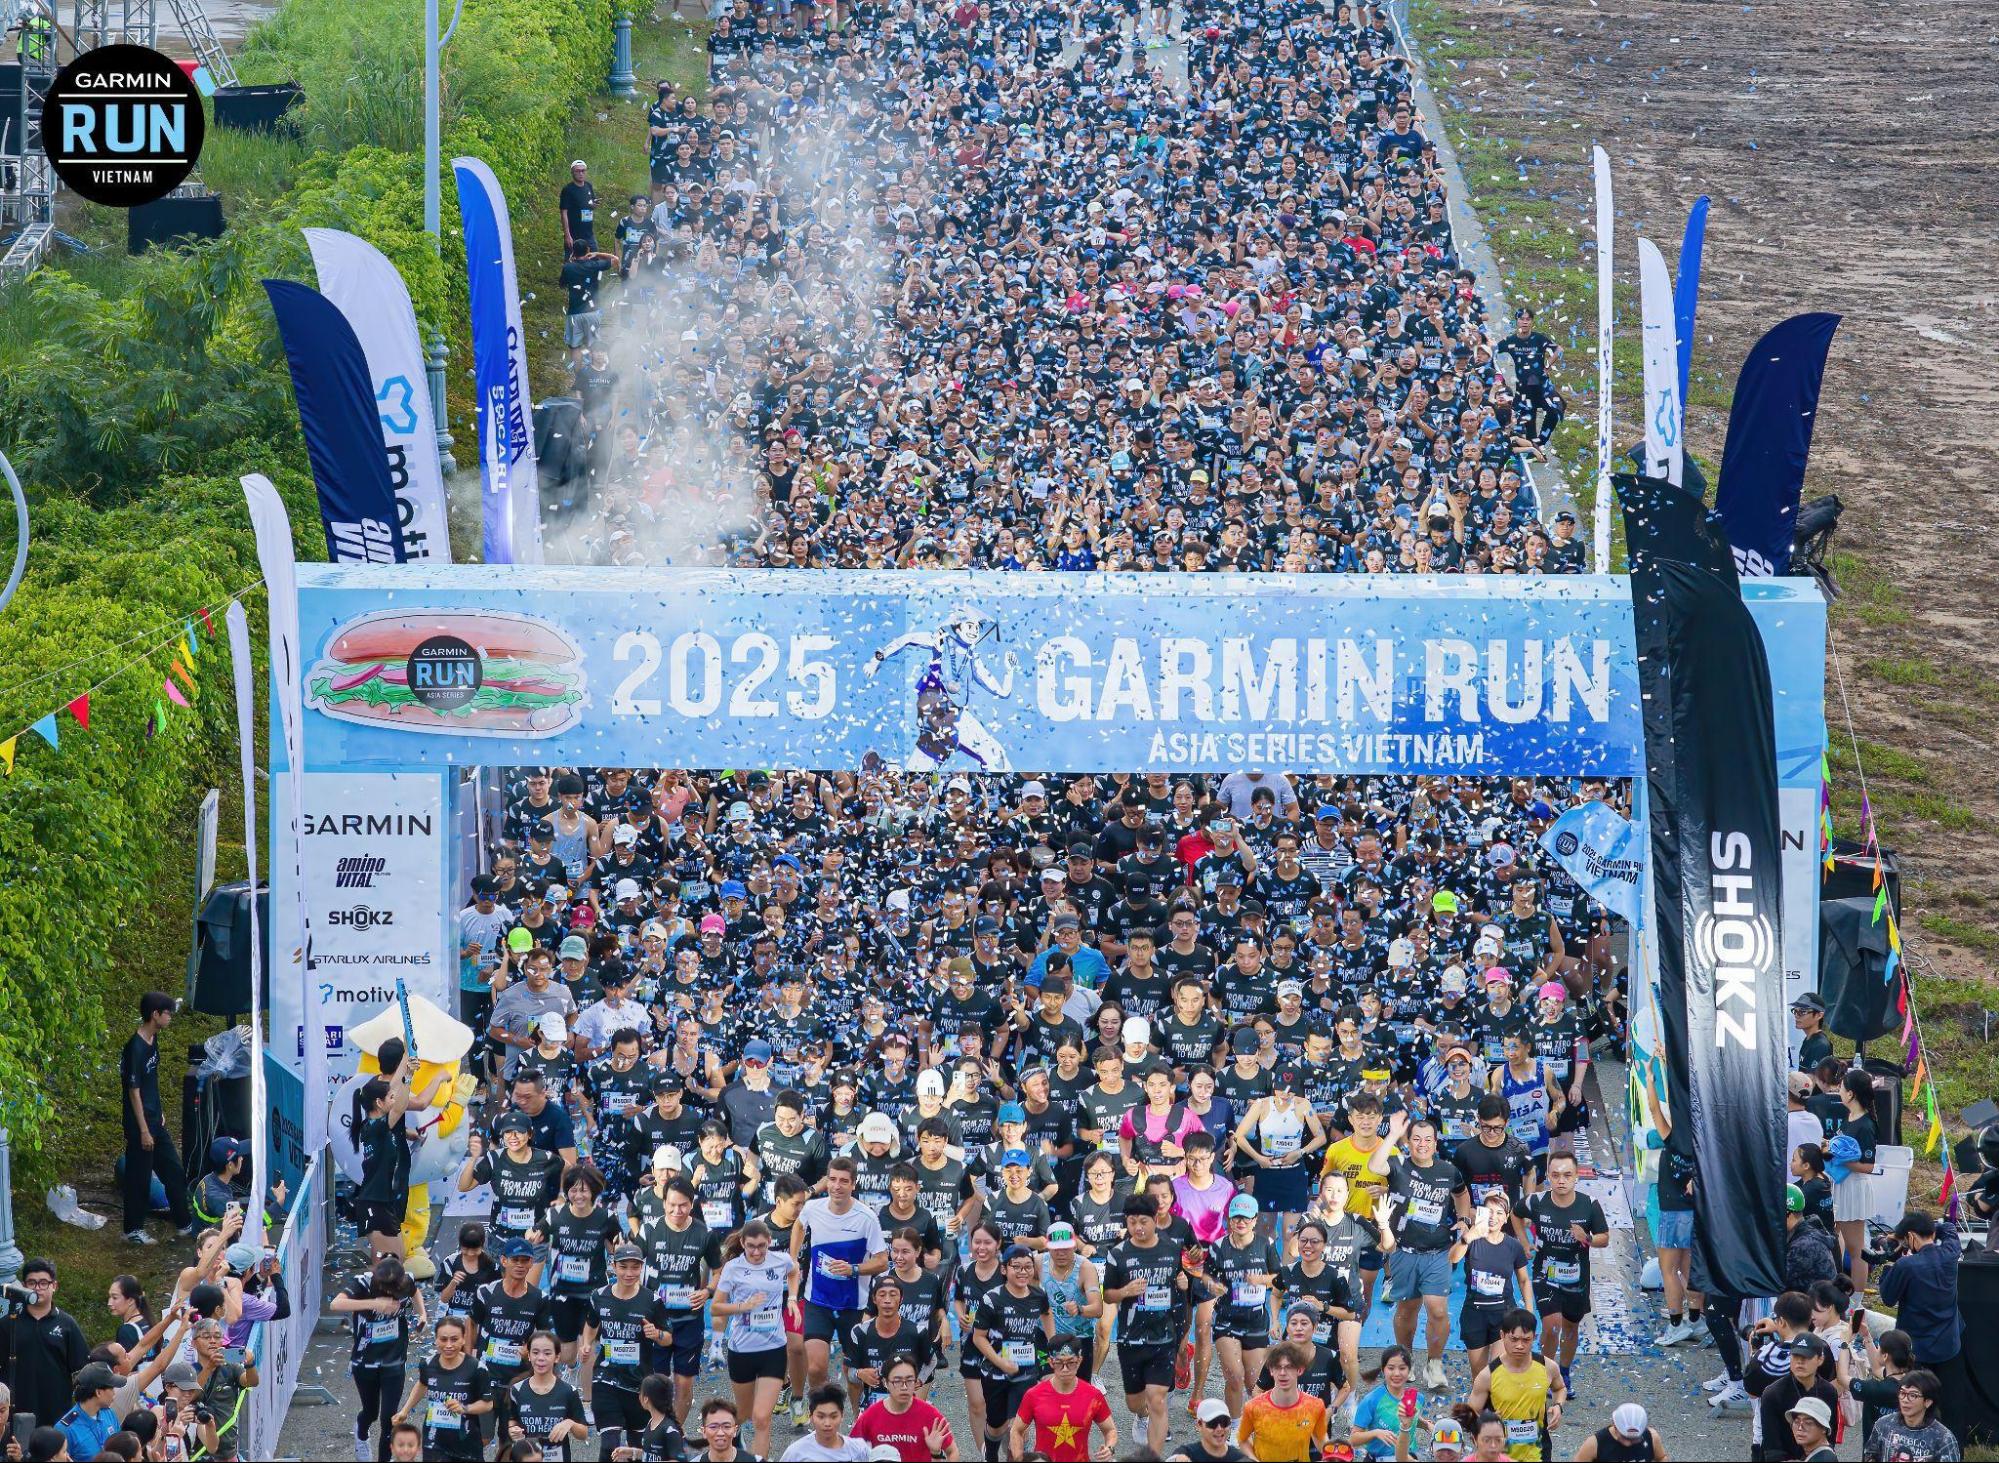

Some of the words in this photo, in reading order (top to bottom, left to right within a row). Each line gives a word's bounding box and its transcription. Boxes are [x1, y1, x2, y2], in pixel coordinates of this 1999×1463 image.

[421, 648, 467, 656] GARMIN
[415, 662, 475, 686] RUN
[612, 631, 836, 719] 2025
[1037, 636, 1392, 722] GARMIN
[1424, 637, 1609, 723] RUN
[426, 691, 442, 699] ASIA
[443, 691, 465, 699] SERIES
[1148, 733, 1218, 763] ASIA
[1227, 733, 1334, 763] SERIES
[1344, 734, 1483, 763] VIETNAM
[292, 815, 431, 836] GARMIN
[336, 853, 386, 872] amino
[1586, 860, 1639, 885] VIETNAM
[336, 873, 374, 888] VITAL
[328, 910, 393, 925] SHOKZ
[1711, 831, 1757, 1049] SHOKZ
[313, 955, 370, 964] STARLUX
[373, 954, 431, 964] AIRLINES
[1143, 999, 1160, 1008] ZERO
[1226, 993, 1244, 1002] FROM
[1246, 994, 1263, 1004] ZERO
[1229, 1001, 1238, 1009] TO
[941, 1017, 960, 1027] FROM
[768, 1037, 787, 1047] FROM
[1171, 1043, 1192, 1052] FROM
[1193, 1042, 1212, 1051] ZERO
[1554, 1040, 1571, 1048] ZERO
[1177, 1051, 1185, 1059] TO
[1187, 1050, 1205, 1059] HERO
[1096, 1115, 1118, 1126] FROM
[762, 1150, 781, 1163] FROM
[783, 1157, 802, 1168] ZERO
[776, 1162, 795, 1174] HERO
[856, 1173, 876, 1183] FROM
[500, 1179, 521, 1189] FROM
[523, 1180, 542, 1189] ZERO
[1408, 1180, 1432, 1191] FROM
[503, 1187, 513, 1196] TO
[515, 1188, 536, 1197] HERO
[935, 1192, 953, 1201] ZERO
[1412, 1189, 1422, 1198] TO
[1424, 1191, 1445, 1202] HERO
[1018, 1222, 1033, 1231] ZERO
[1083, 1224, 1103, 1234] FROM
[1540, 1226, 1561, 1236] FROM
[1333, 1246, 1353, 1254] ZERO
[656, 1253, 675, 1263] FROM
[676, 1254, 696, 1264] ZERO
[1327, 1253, 1345, 1262] HERO
[660, 1262, 669, 1271] TO
[670, 1262, 689, 1272] HERO
[1129, 1269, 1151, 1279] FROM
[1154, 1267, 1172, 1278] ZERO
[490, 1317, 511, 1327] FROM
[512, 1319, 530, 1329] ZERO
[601, 1321, 621, 1331] FROM
[622, 1322, 641, 1332] ZERO
[1004, 1317, 1024, 1328] FROM
[504, 1327, 524, 1335] HERO
[616, 1330, 636, 1339] HERO
[1306, 1383, 1325, 1391] ZERO
[450, 1391, 467, 1400] ZERO
[521, 1416, 544, 1425] FROM
[526, 1425, 535, 1433] TO
[876, 1433, 918, 1444] GARMIN
